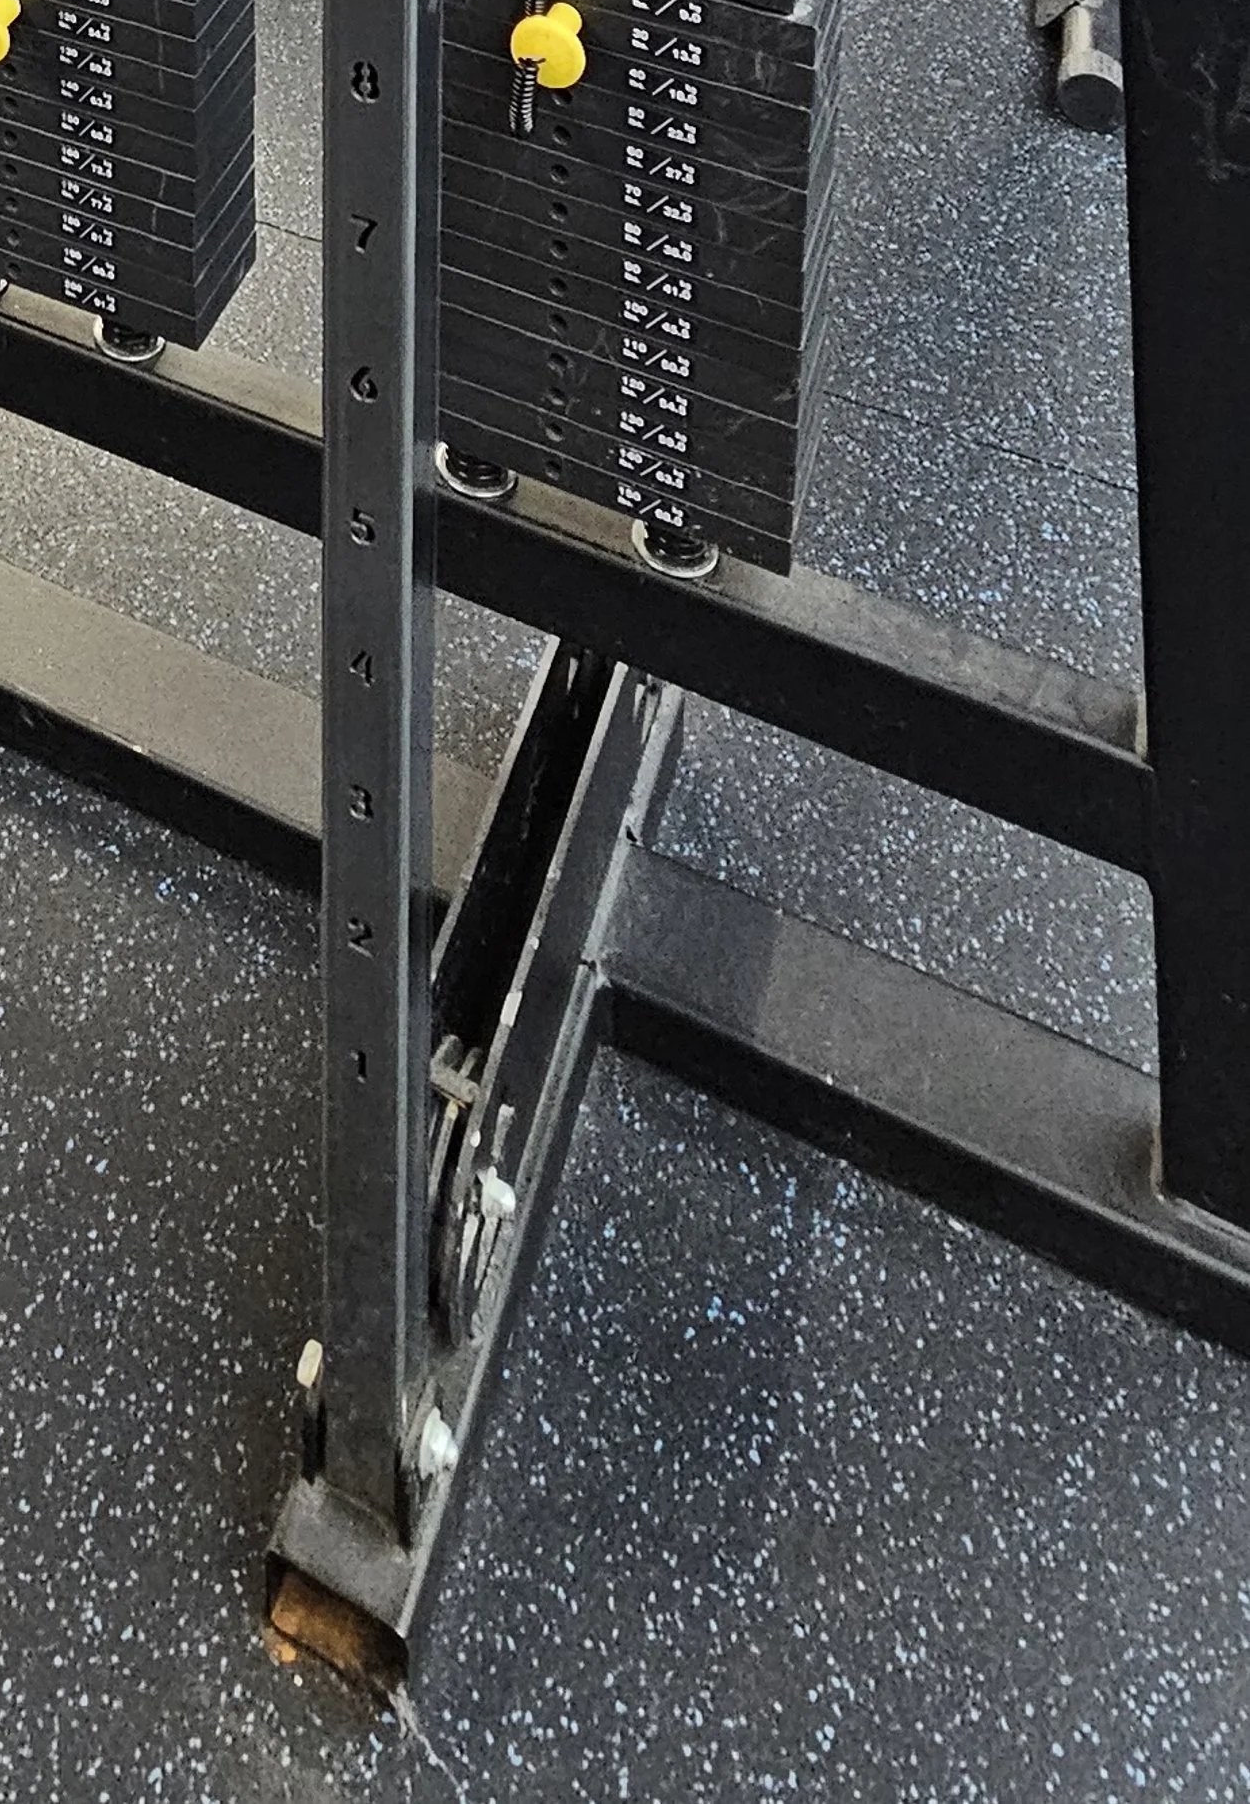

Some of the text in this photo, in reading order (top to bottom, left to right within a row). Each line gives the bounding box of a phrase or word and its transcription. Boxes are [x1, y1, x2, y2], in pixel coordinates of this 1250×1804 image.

[350, 61, 380, 104] 8
[626, 184, 641, 196] 70
[348, 213, 378, 255] 7
[623, 338, 647, 353] 110
[350, 366, 379, 404] 6
[350, 507, 376, 547] 5
[349, 650, 375, 688] 4
[349, 785, 375, 823] 3
[347, 917, 375, 961] 2
[349, 1049, 367, 1085] 1
